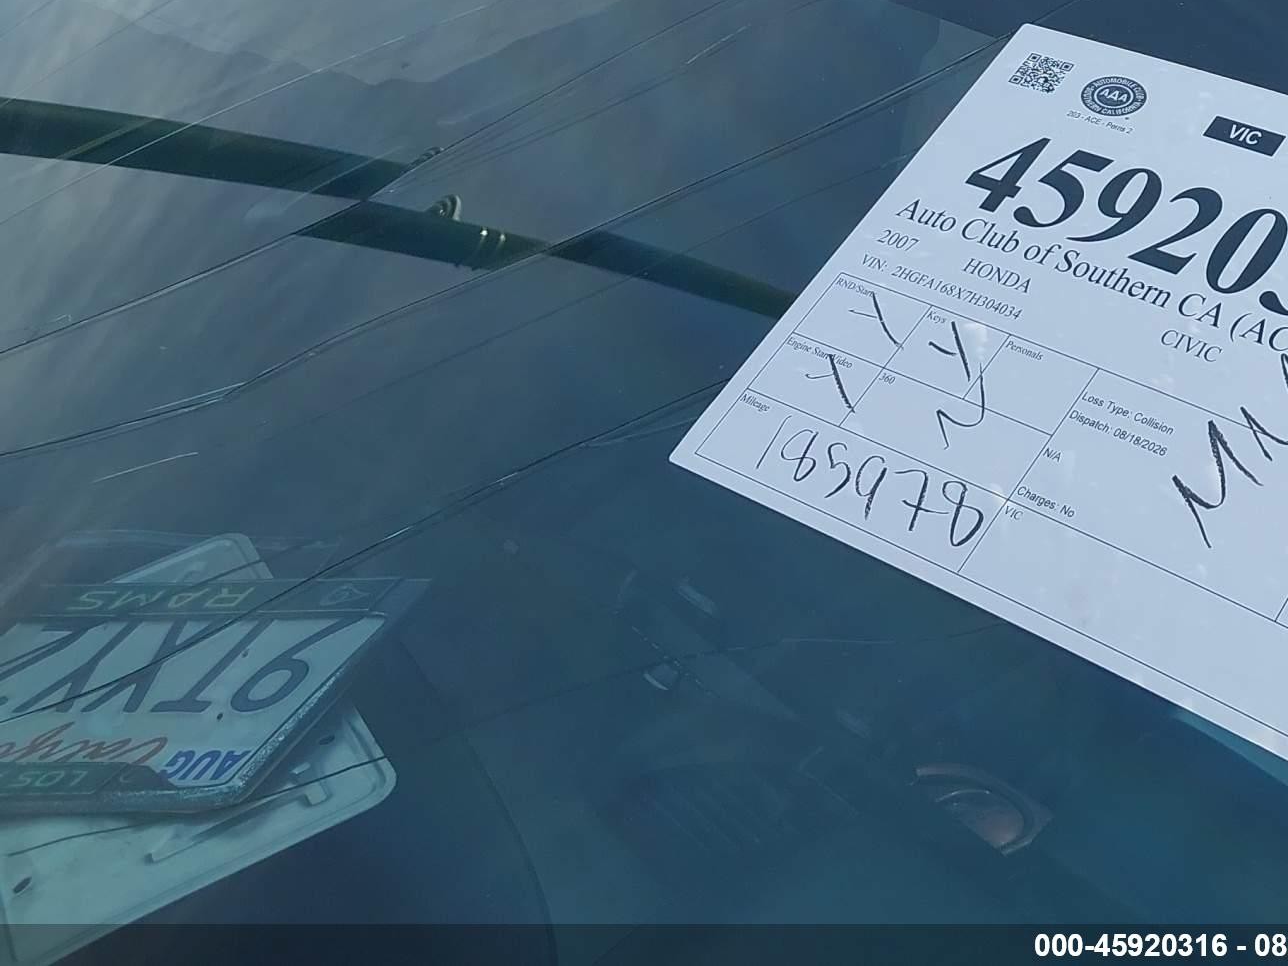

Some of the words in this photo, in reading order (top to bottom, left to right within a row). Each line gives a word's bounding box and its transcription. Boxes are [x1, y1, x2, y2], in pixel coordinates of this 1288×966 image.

[1099, 88, 1130, 103] AAA
[1085, 115, 1101, 125] ACE
[1230, 124, 1262, 145] VIC
[877, 229, 919, 252] 2007
[860, 254, 888, 273] VIN:
[896, 199, 956, 232] Auto
[961, 218, 1020, 253] Club
[1023, 243, 1062, 266] of
[1055, 250, 1171, 308] Southern
[1178, 293, 1222, 328] CA
[962, 258, 1031, 294] HONDA
[926, 310, 947, 324] Keys
[786, 337, 812, 353] Engine
[1005, 341, 1043, 361] Personals
[1161, 329, 1222, 363] CIVIC
[879, 373, 896, 385] 360
[740, 393, 770, 412] Mileage
[1081, 391, 1105, 409] Loss
[1107, 401, 1132, 420] Type:
[1133, 411, 1175, 436] Collision
[1068, 410, 1113, 437] Dispatch:
[1113, 426, 1168, 458] 08/18/2026
[1043, 447, 1063, 463] N/A
[755, 415, 984, 547] 185978
[1016, 486, 1060, 512] Charges:
[1060, 503, 1076, 518] No
[1004, 505, 1023, 521] VIC
[66, 585, 255, 611] RAMS
[165, 748, 254, 782] AUG
[16, 769, 86, 786] LOS
